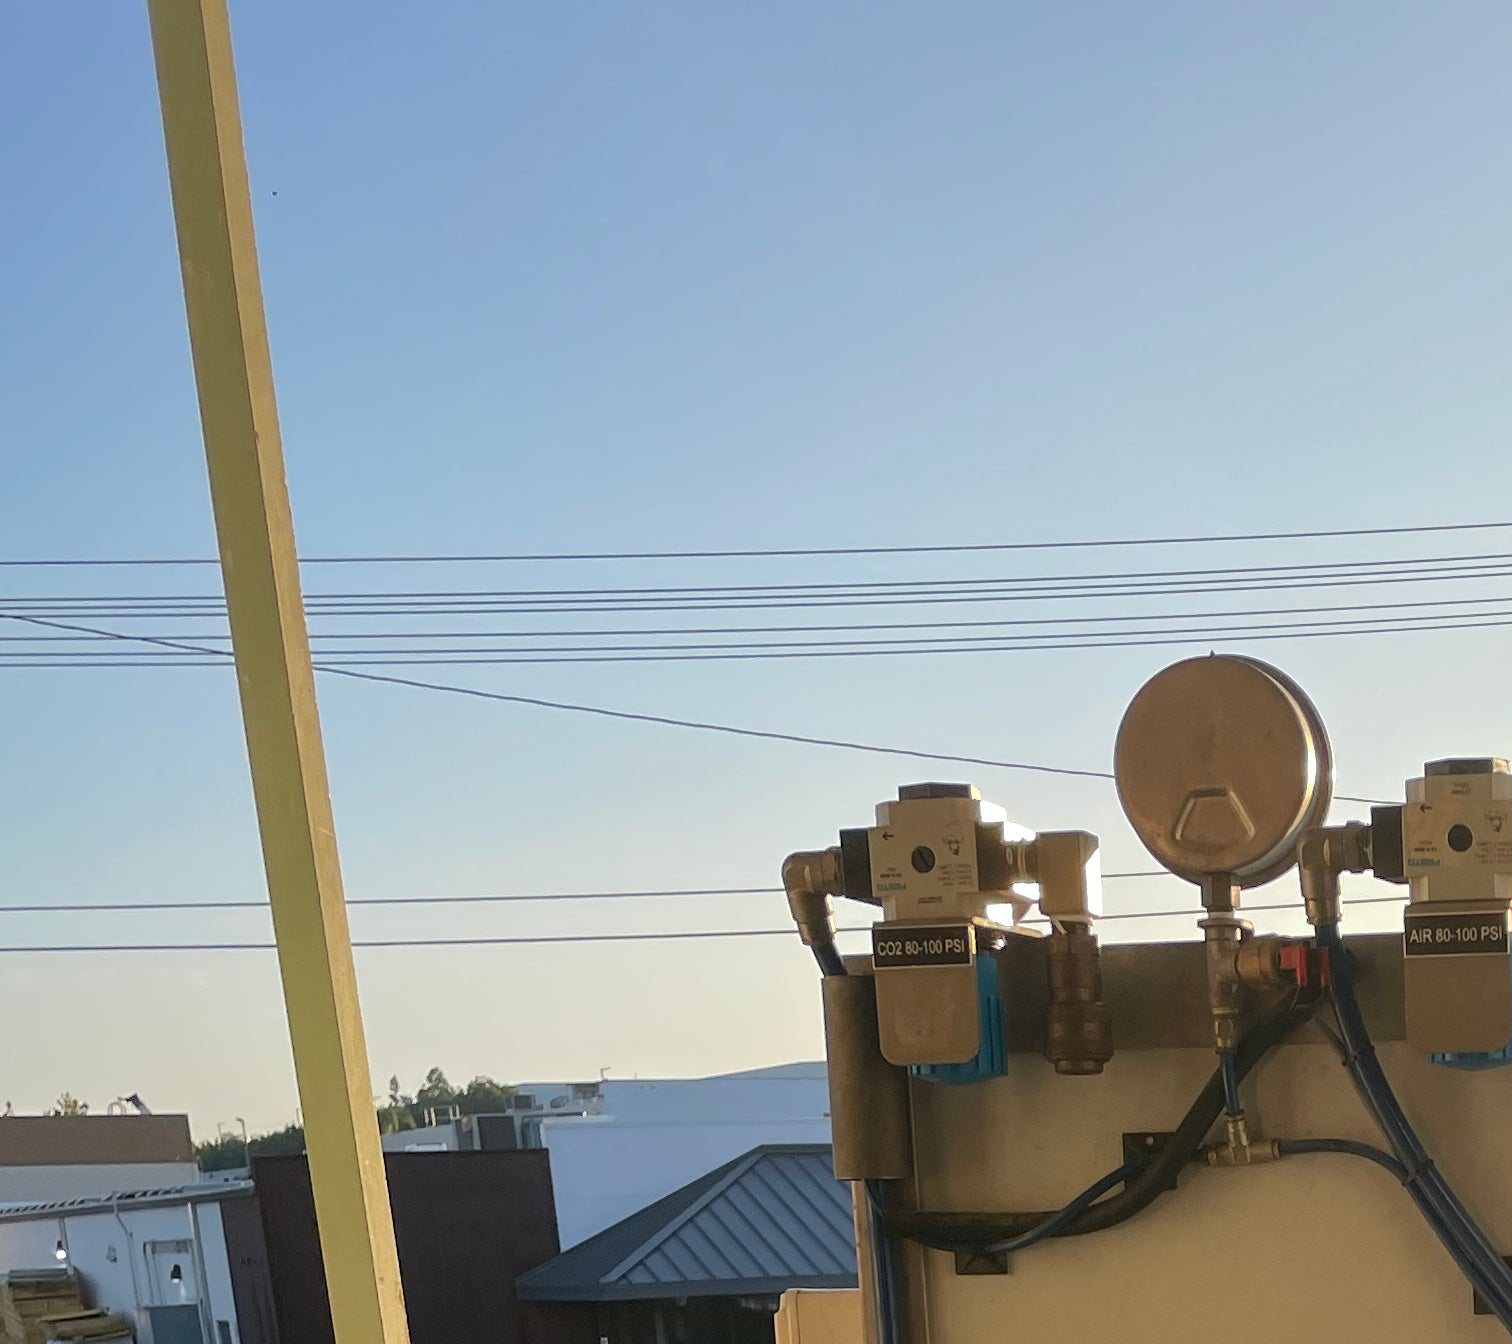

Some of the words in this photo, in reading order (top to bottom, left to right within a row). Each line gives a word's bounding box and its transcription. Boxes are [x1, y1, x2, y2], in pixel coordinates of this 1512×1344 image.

[1409, 928, 1433, 944] AIR
[1435, 927, 1478, 943] 80-100
[1480, 926, 1503, 941] PSI
[877, 941, 903, 956] CO2
[945, 938, 965, 953] PSI
